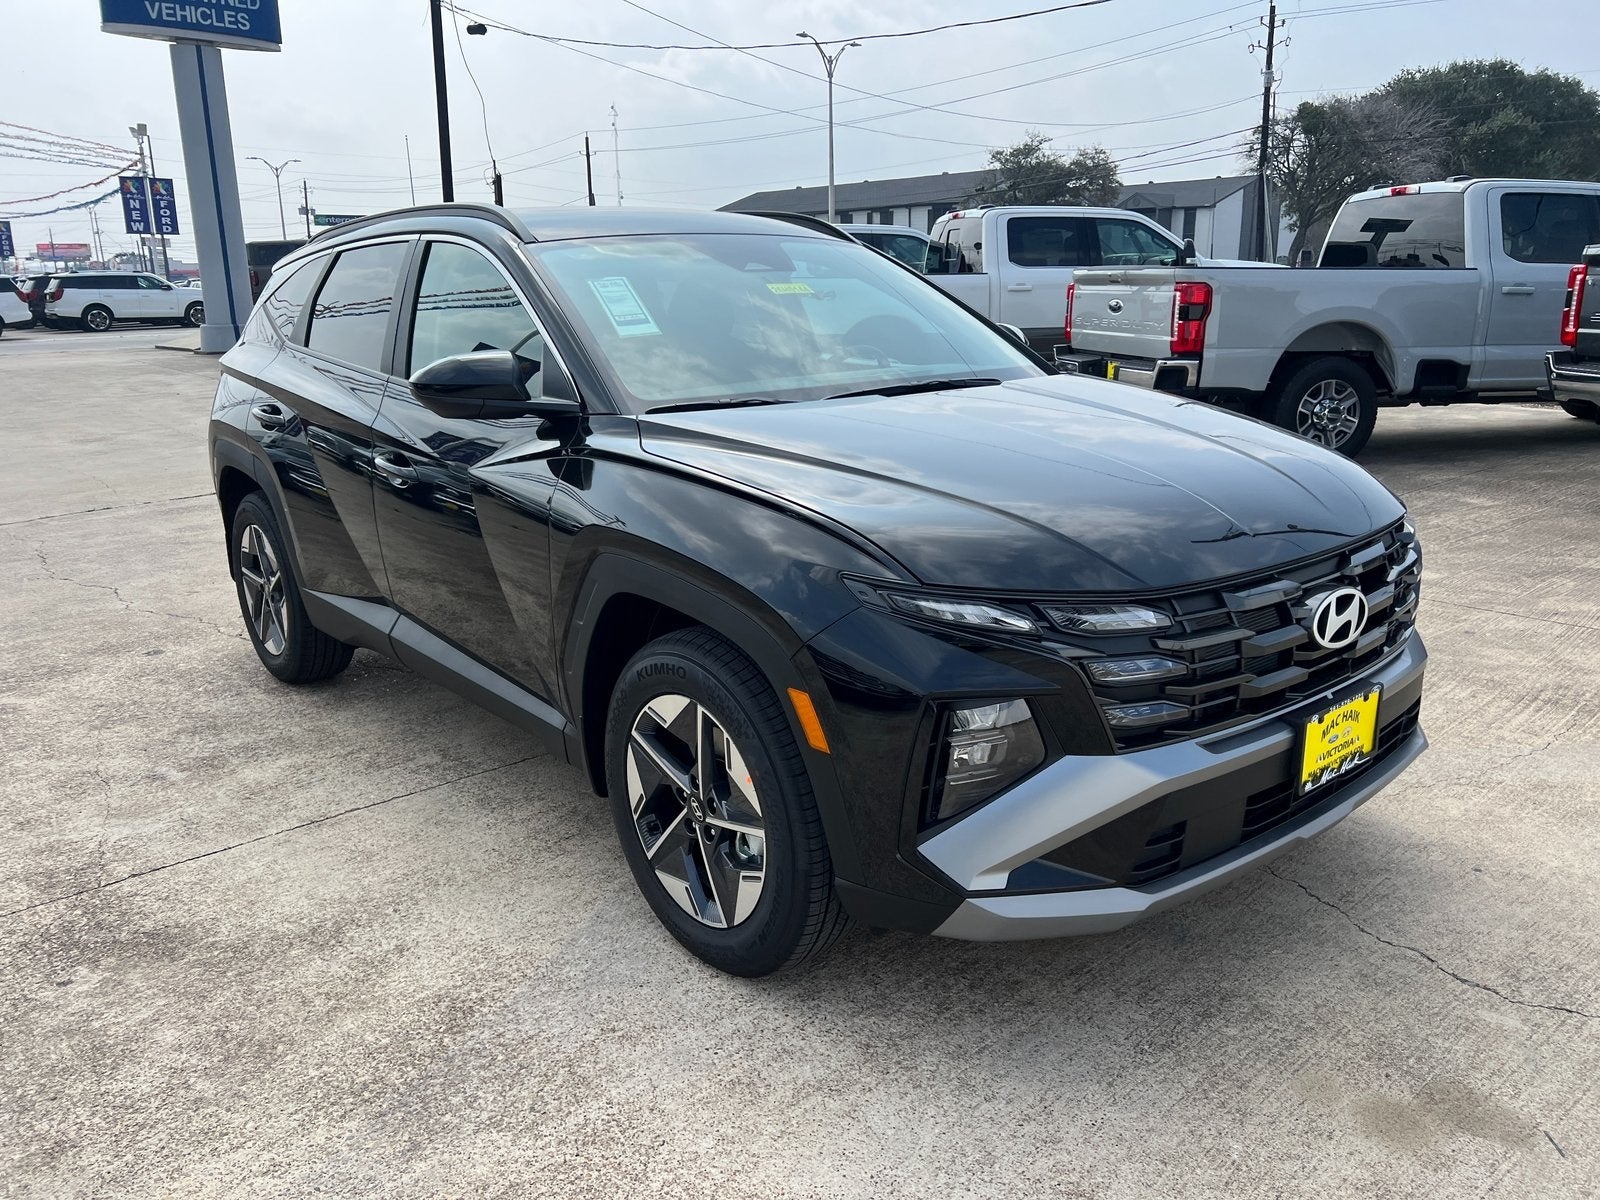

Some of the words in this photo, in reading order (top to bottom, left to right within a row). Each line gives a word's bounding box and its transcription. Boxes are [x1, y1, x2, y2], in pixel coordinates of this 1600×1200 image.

[144, 1, 250, 30] VEHICLES
[129, 199, 144, 232] NEW
[159, 200, 172, 233] FORD
[636, 663, 687, 682] KUMHO
[1321, 715, 1341, 742] MAC
[1342, 709, 1360, 723] HAIK
[1322, 737, 1355, 762] VICTORIA
